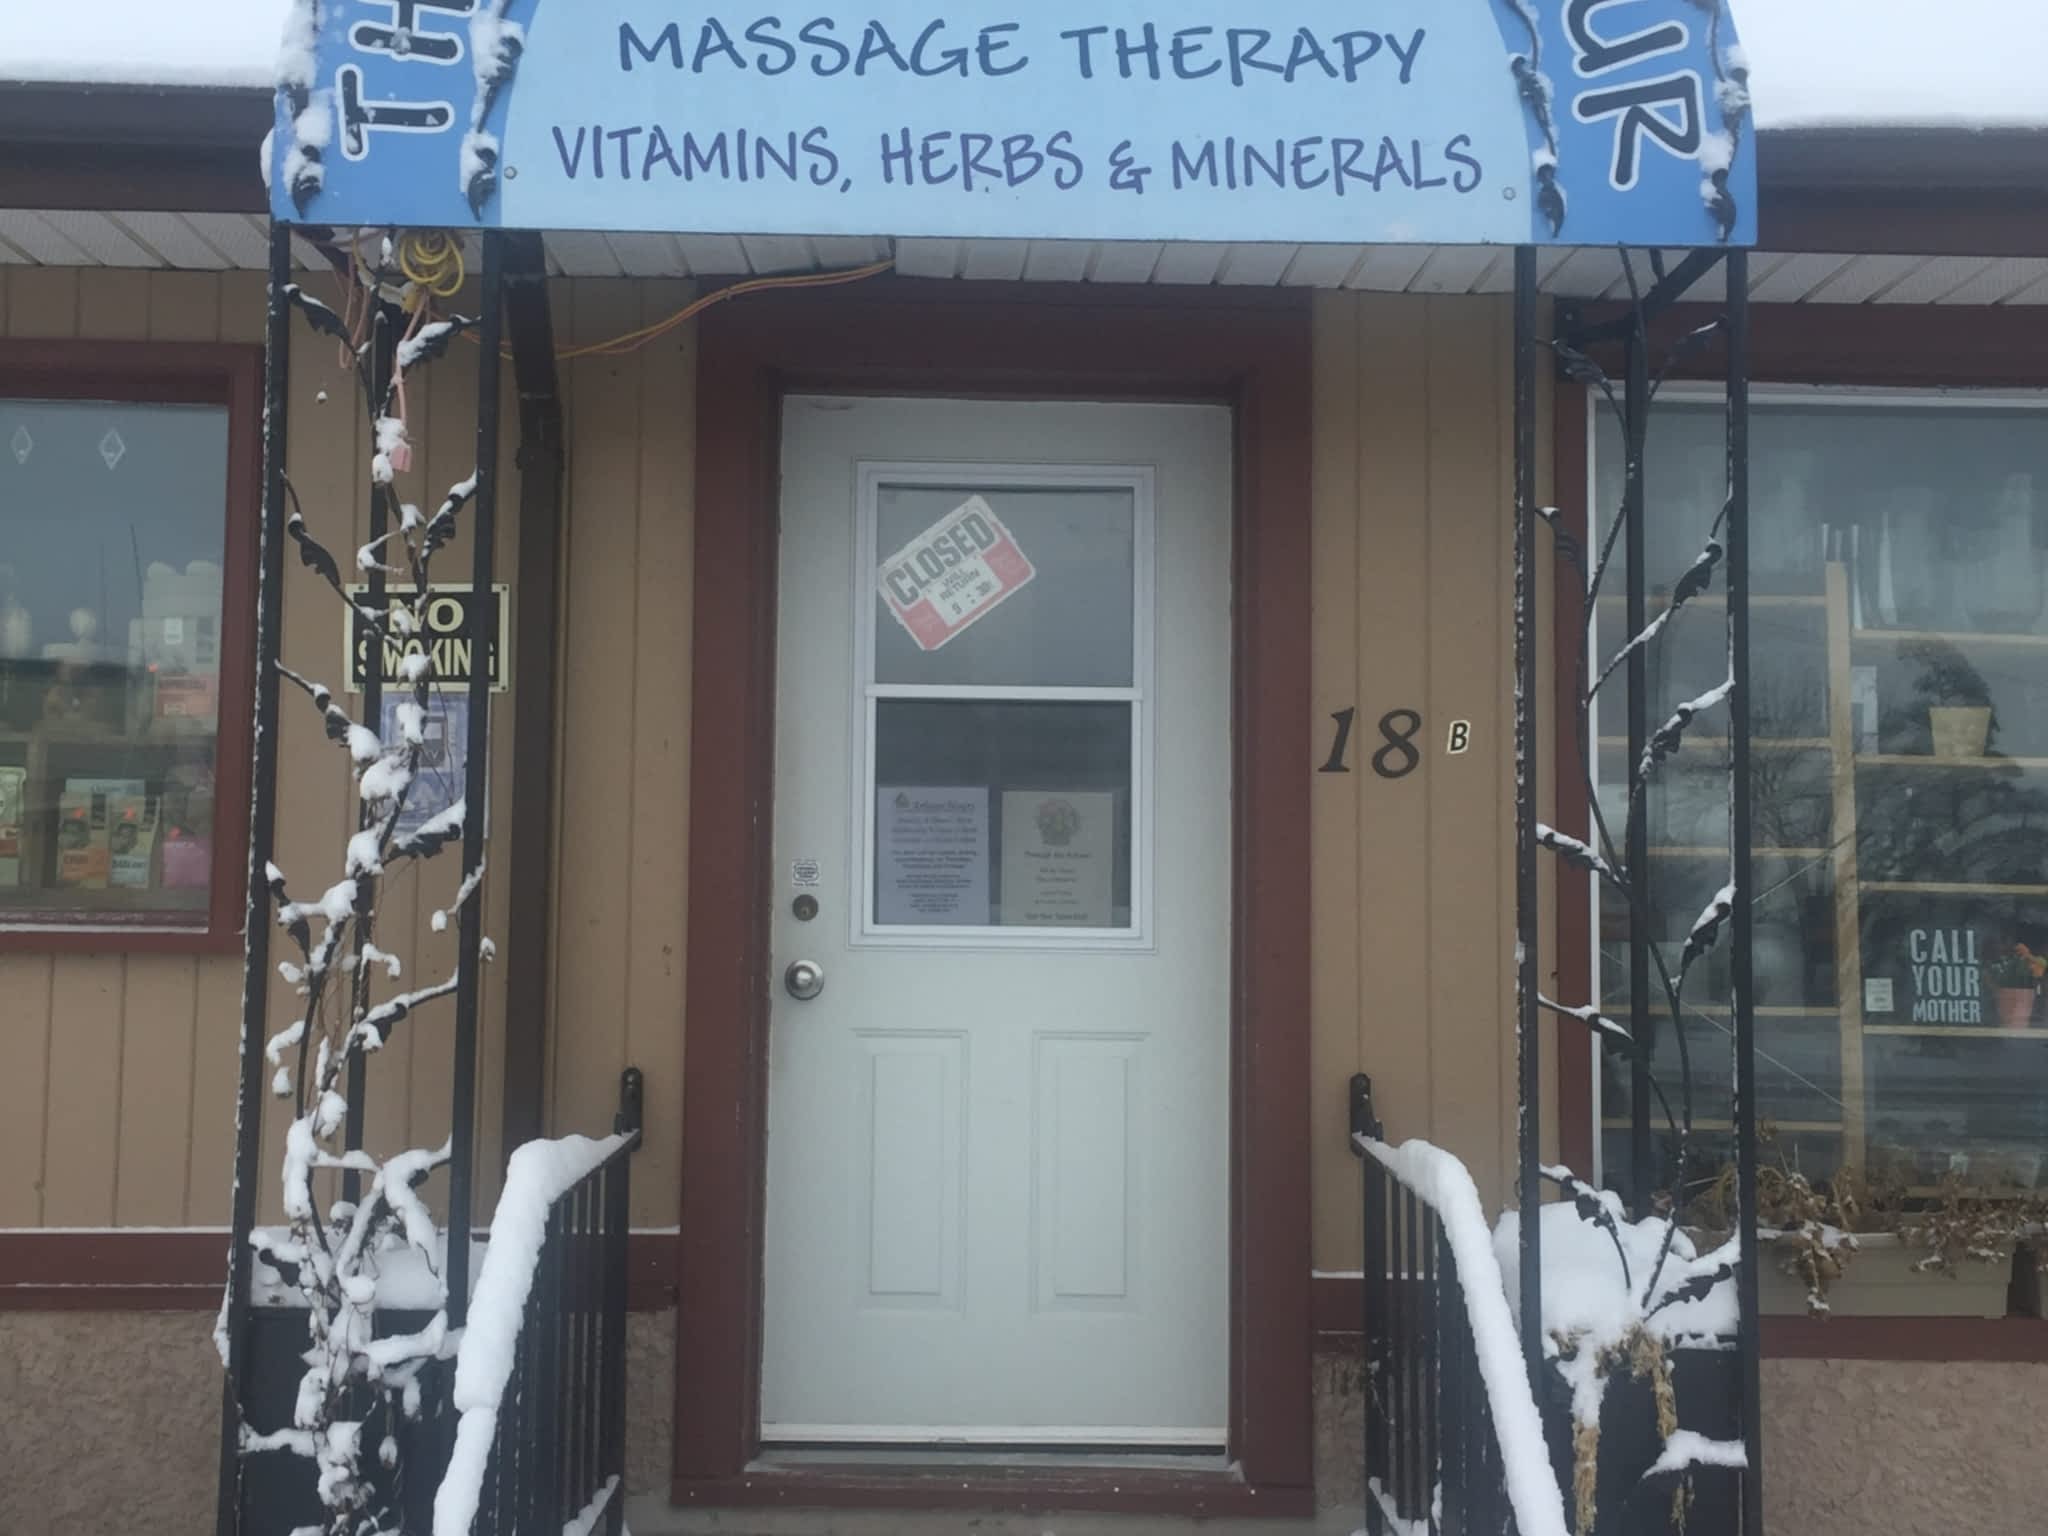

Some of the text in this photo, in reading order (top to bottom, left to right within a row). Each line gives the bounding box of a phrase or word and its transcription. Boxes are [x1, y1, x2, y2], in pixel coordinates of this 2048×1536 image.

[618, 16, 1426, 88] MASSAGE THERAPY
[551, 124, 1482, 197] VITAMINS, HERBS & MINERALS
[885, 512, 996, 607] CLOSED
[388, 597, 465, 633] NO
[357, 637, 495, 678] MKIN
[1317, 705, 1470, 779] 18 B
[1909, 928, 1980, 964] CALL
[1911, 965, 1980, 998] YOUR
[1912, 999, 1981, 1023] MOTHER
